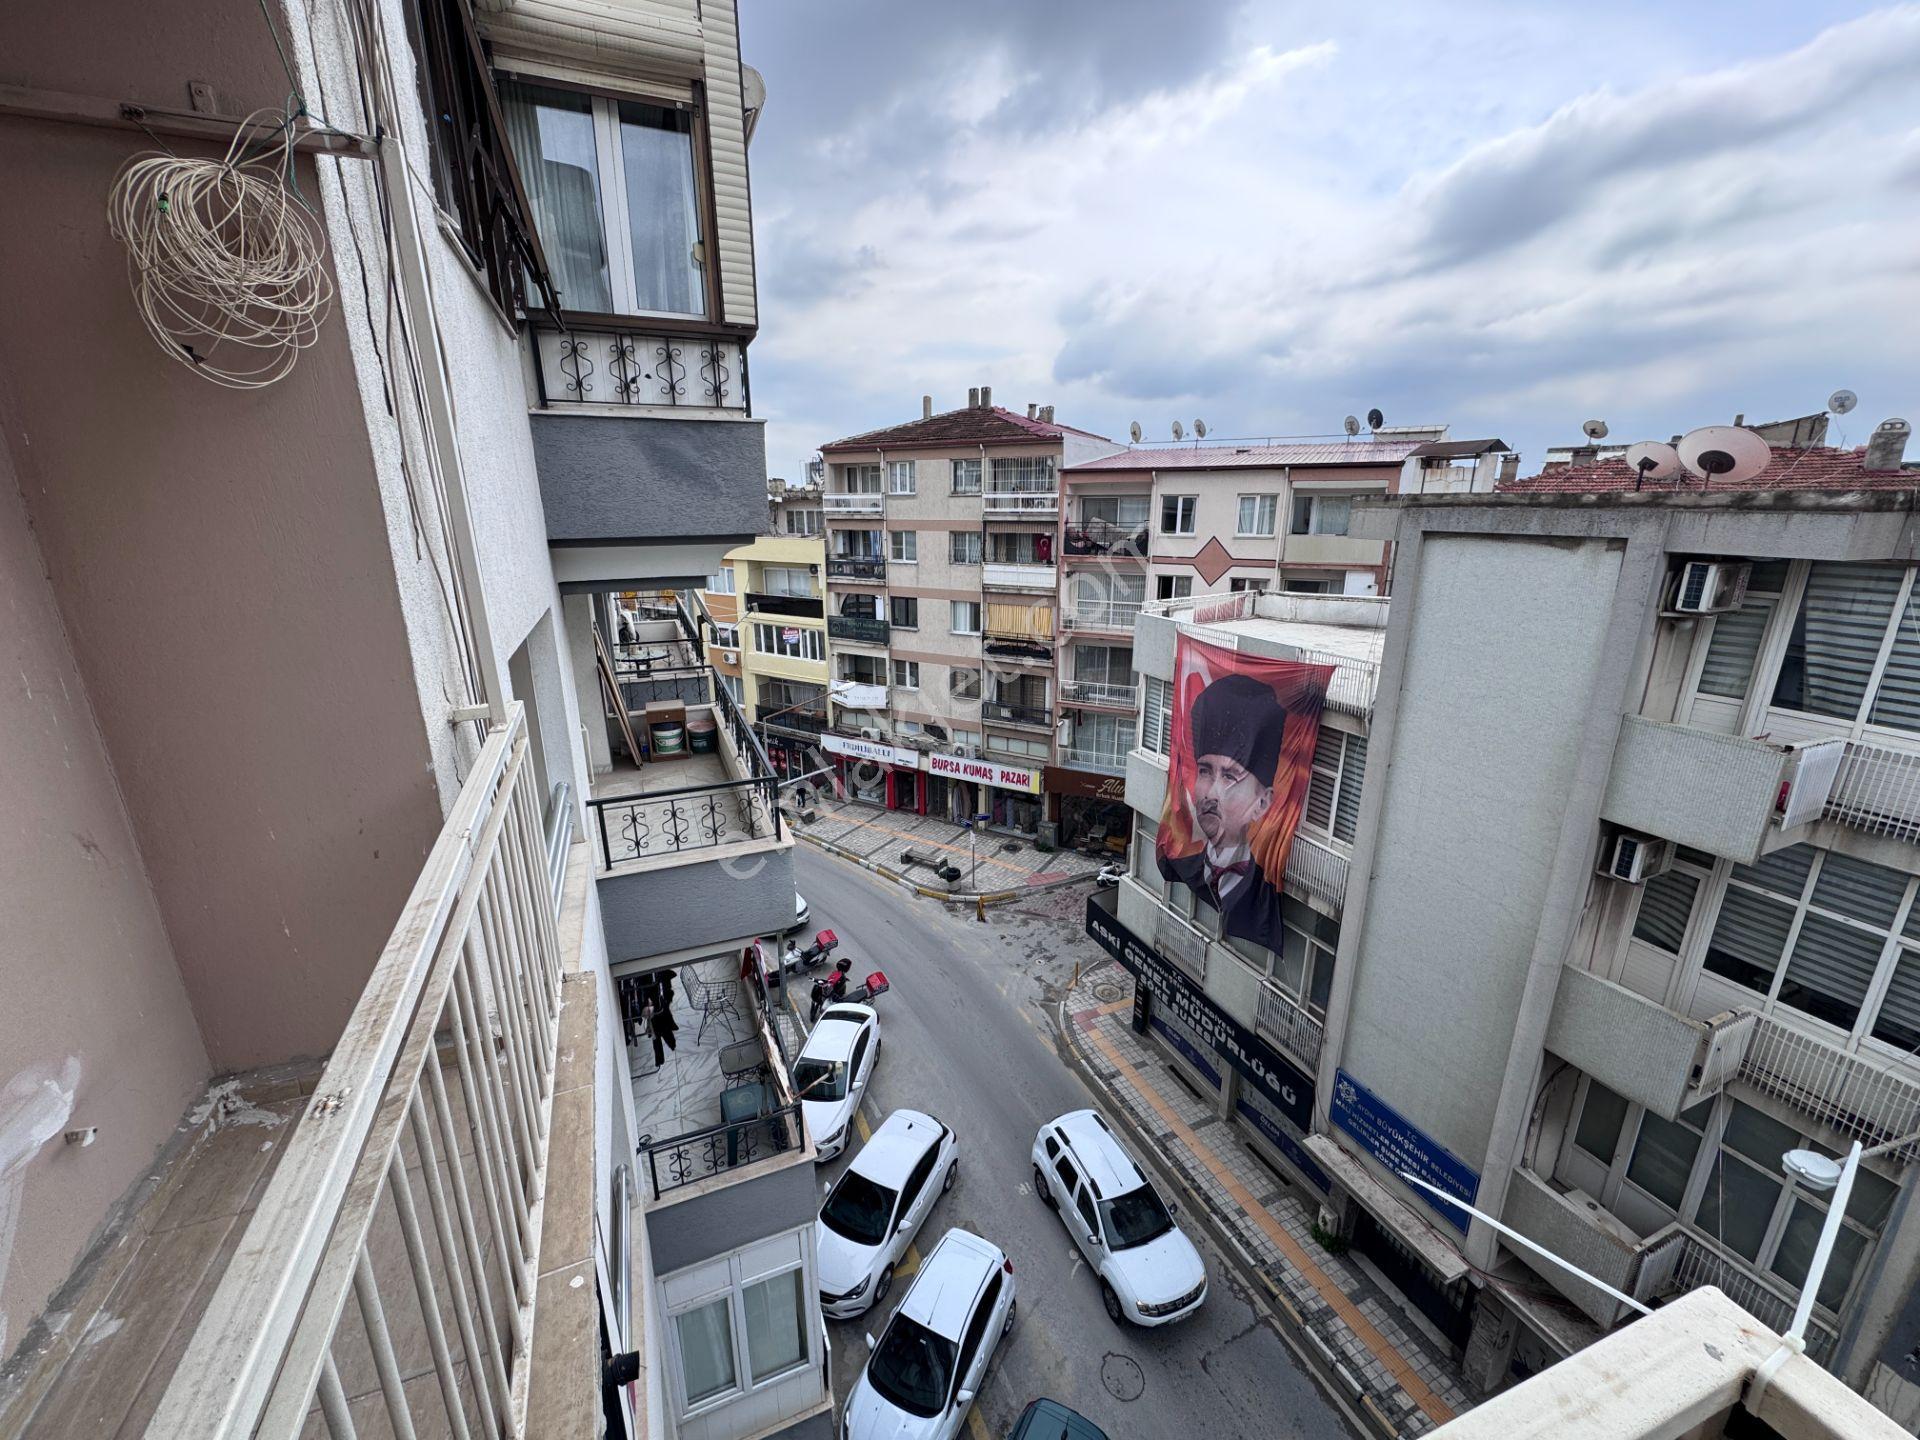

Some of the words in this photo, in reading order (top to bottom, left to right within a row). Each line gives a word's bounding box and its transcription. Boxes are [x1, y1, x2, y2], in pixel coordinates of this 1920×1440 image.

[931, 757, 960, 774] BURSA
[963, 763, 993, 782] KUMAŞ
[1000, 770, 1030, 788] PAZARI
[1092, 920, 1120, 950] ASKİ
[1125, 947, 1171, 995] GENEL
[1176, 990, 1297, 1106] MÜDÜRLÜĞÜ
[1128, 941, 1146, 959] AYDIN
[1191, 995, 1235, 1037] BELEDİYESİ
[1140, 974, 1169, 1005] SÖKE
[1172, 1002, 1216, 1048] ŞUBESİ
[1348, 1118, 1380, 1148] GELİRLER
[1381, 1145, 1400, 1164] ŞUBE
[1352, 1110, 1390, 1146] HİZMETLER
[1391, 1143, 1420, 1171] DAİRESİ
[1358, 1104, 1375, 1121] AYDIN
[1377, 1117, 1430, 1164] BÜYÜKŞEHİR
[1431, 1162, 1472, 1198] BELEDİYESİ
[1374, 1150, 1394, 1169] SÖKE
